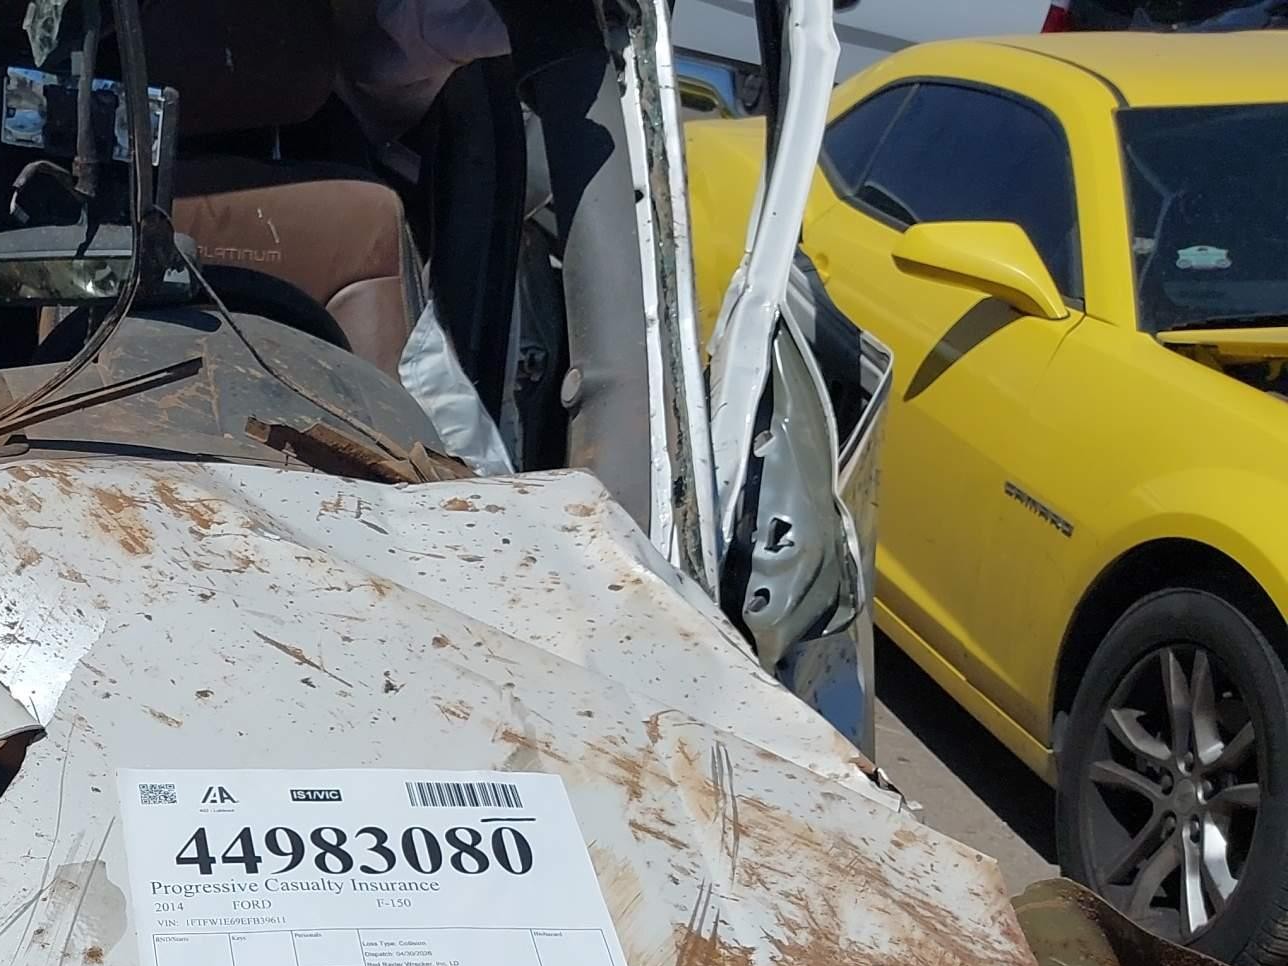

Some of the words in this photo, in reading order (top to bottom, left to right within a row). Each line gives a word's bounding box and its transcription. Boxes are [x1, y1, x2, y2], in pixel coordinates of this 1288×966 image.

[1004, 481, 1074, 538] CAMARO
[175, 826, 534, 875] 44983080
[151, 879, 259, 898] Progressive
[264, 877, 344, 895] Casualty
[350, 878, 440, 892] Insurance
[155, 902, 184, 913] 2014
[232, 899, 272, 911] FORD
[376, 897, 412, 909] F-150
[157, 918, 179, 928] VIN:
